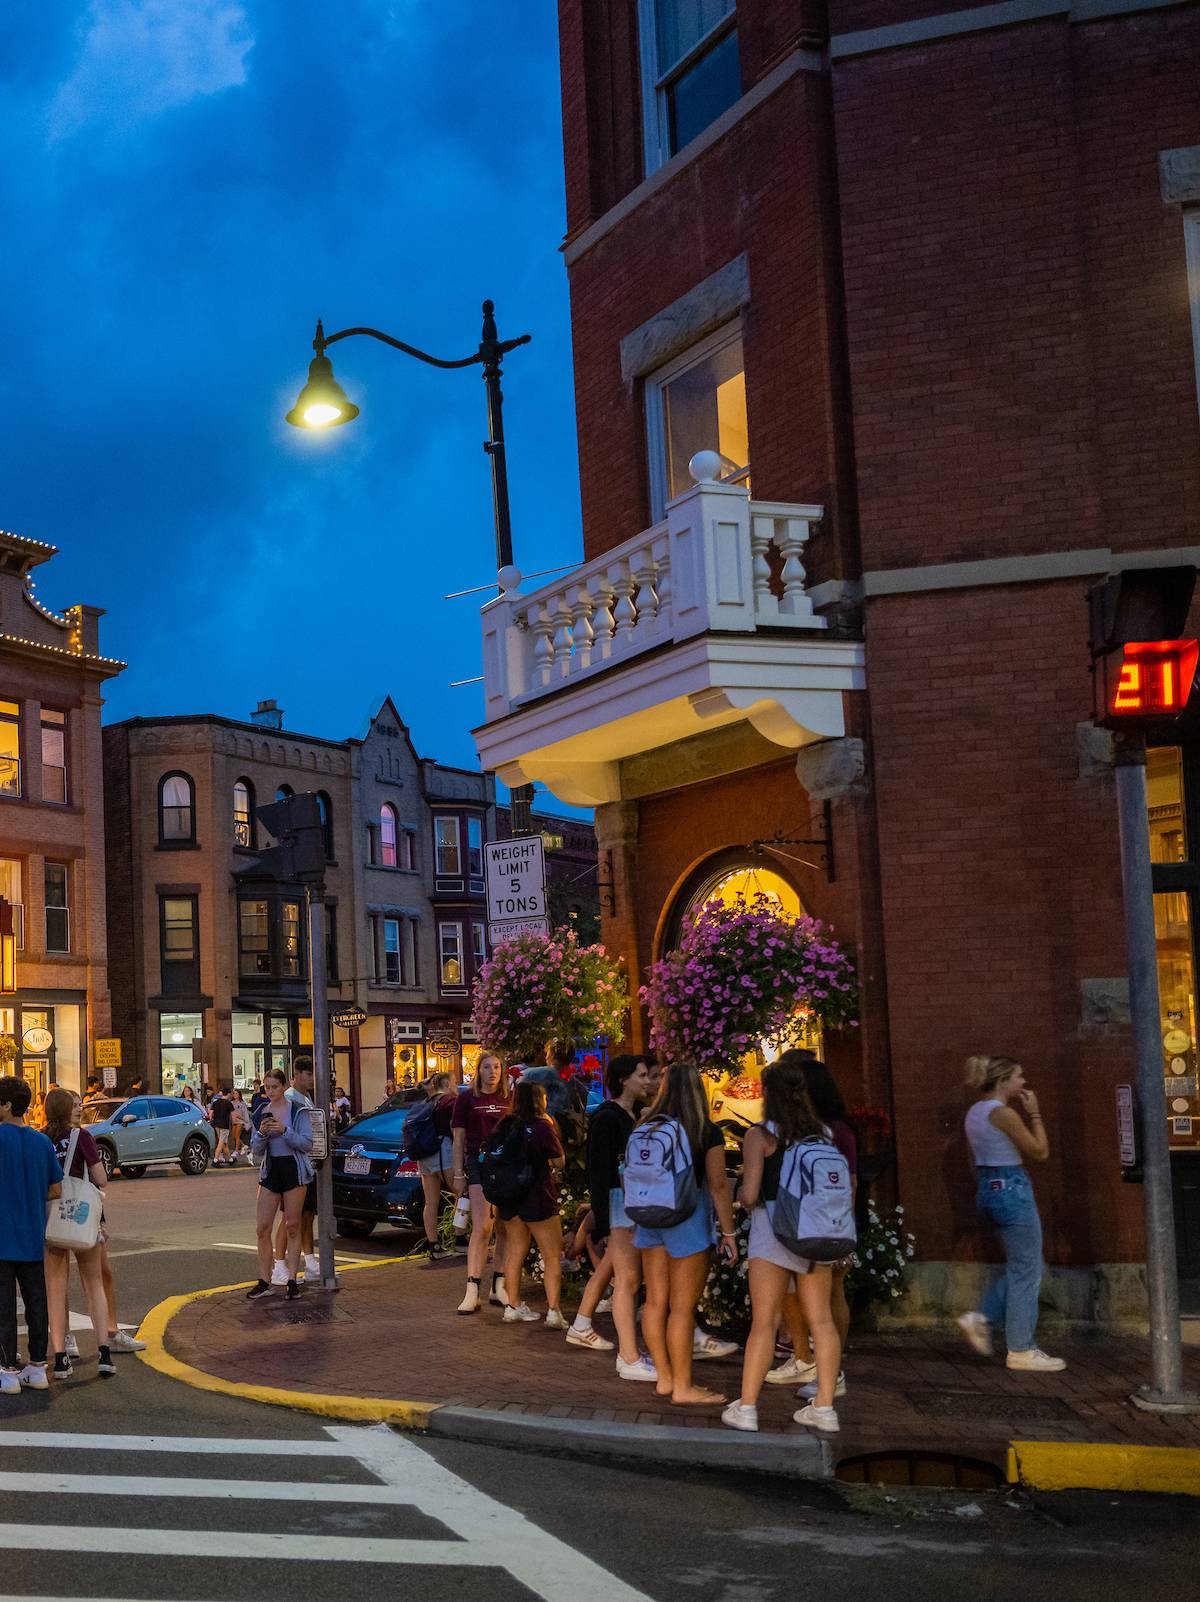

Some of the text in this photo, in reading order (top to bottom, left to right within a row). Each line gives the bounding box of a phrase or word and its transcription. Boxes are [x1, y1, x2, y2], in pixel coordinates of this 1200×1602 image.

[1115, 661, 1173, 708] 21
[491, 844, 536, 861] WEIGHT
[498, 860, 531, 876] LIMIT
[510, 878, 521, 893] 5
[495, 896, 538, 914] TONS
[493, 924, 518, 933] EXCEPT
